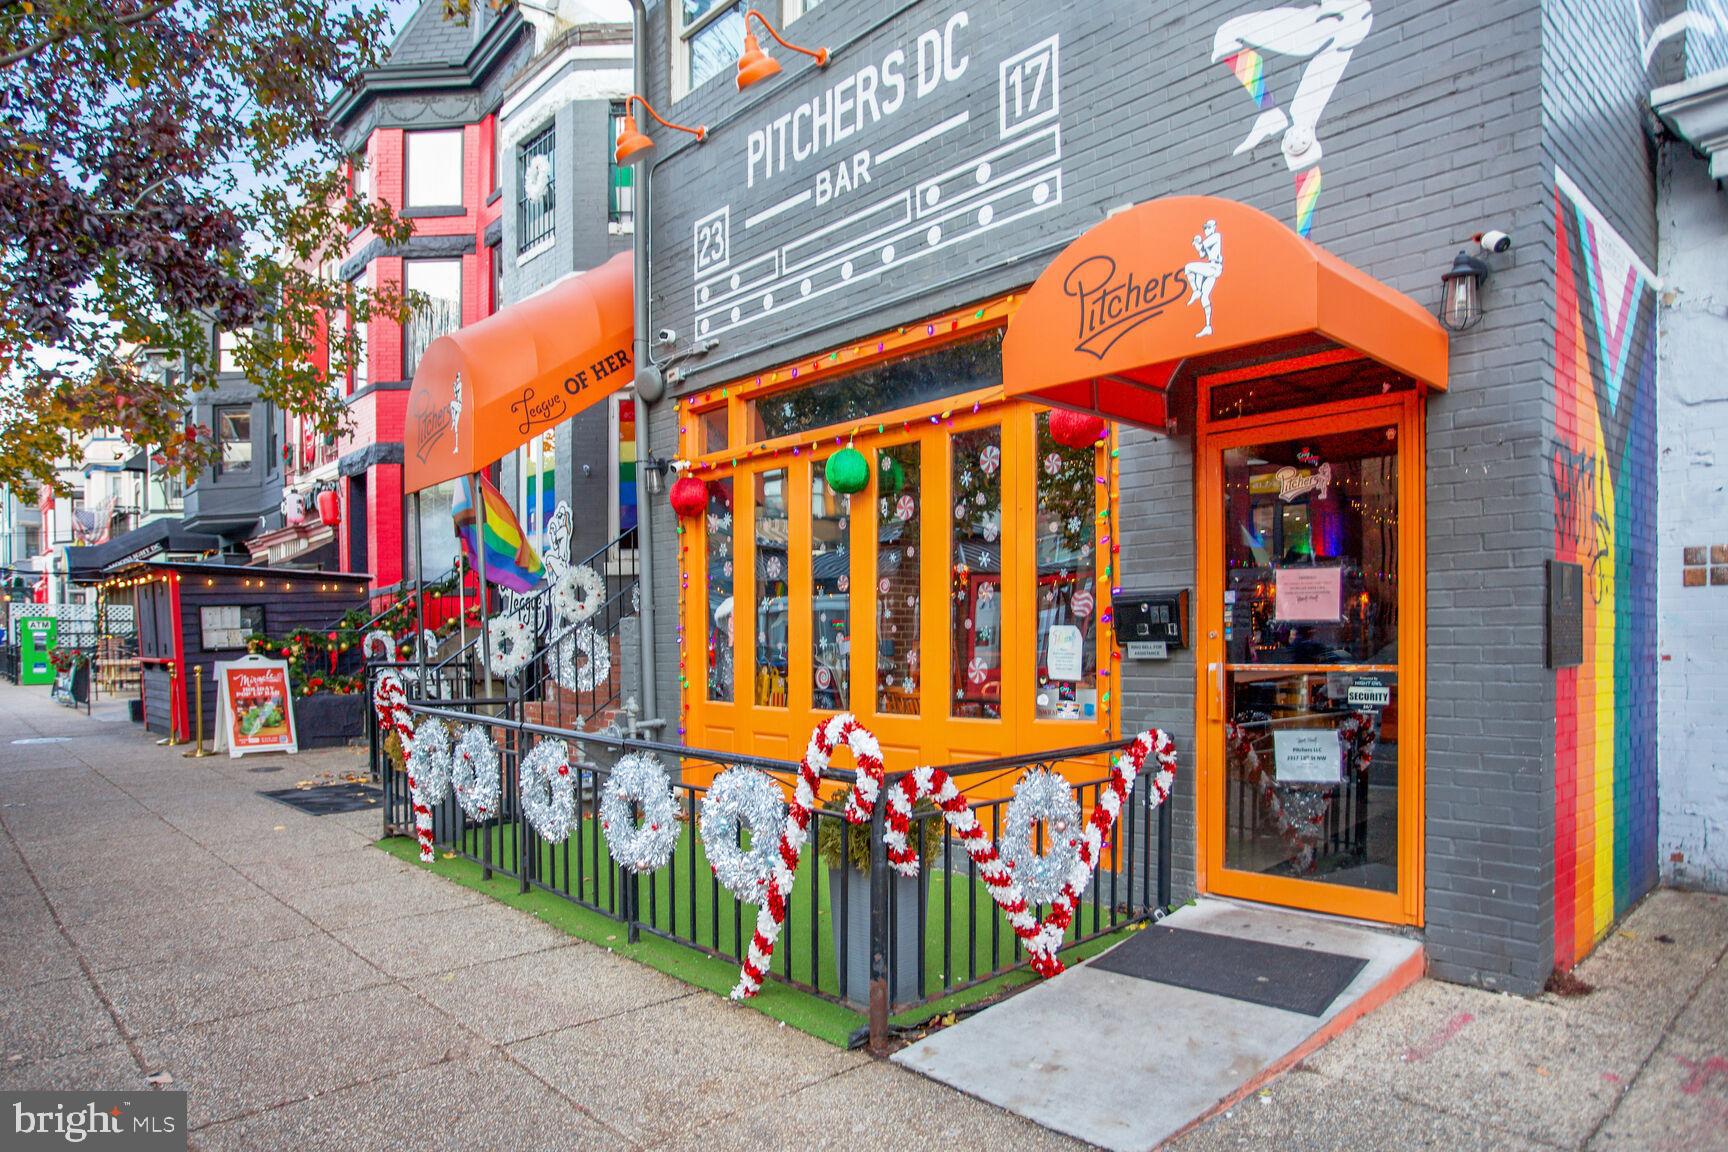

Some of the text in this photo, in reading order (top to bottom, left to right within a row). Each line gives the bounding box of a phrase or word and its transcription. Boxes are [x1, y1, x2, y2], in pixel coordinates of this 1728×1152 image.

[747, 10, 970, 190] PITCHERS DC
[1008, 50, 1051, 118] 17
[815, 149, 872, 208] BAR
[698, 220, 725, 269] 23
[1063, 255, 1188, 342] Pitchers
[510, 348, 632, 435] League OF HER
[30, 621, 50, 629] ATM
[1349, 691, 1388, 702] SECURITY
